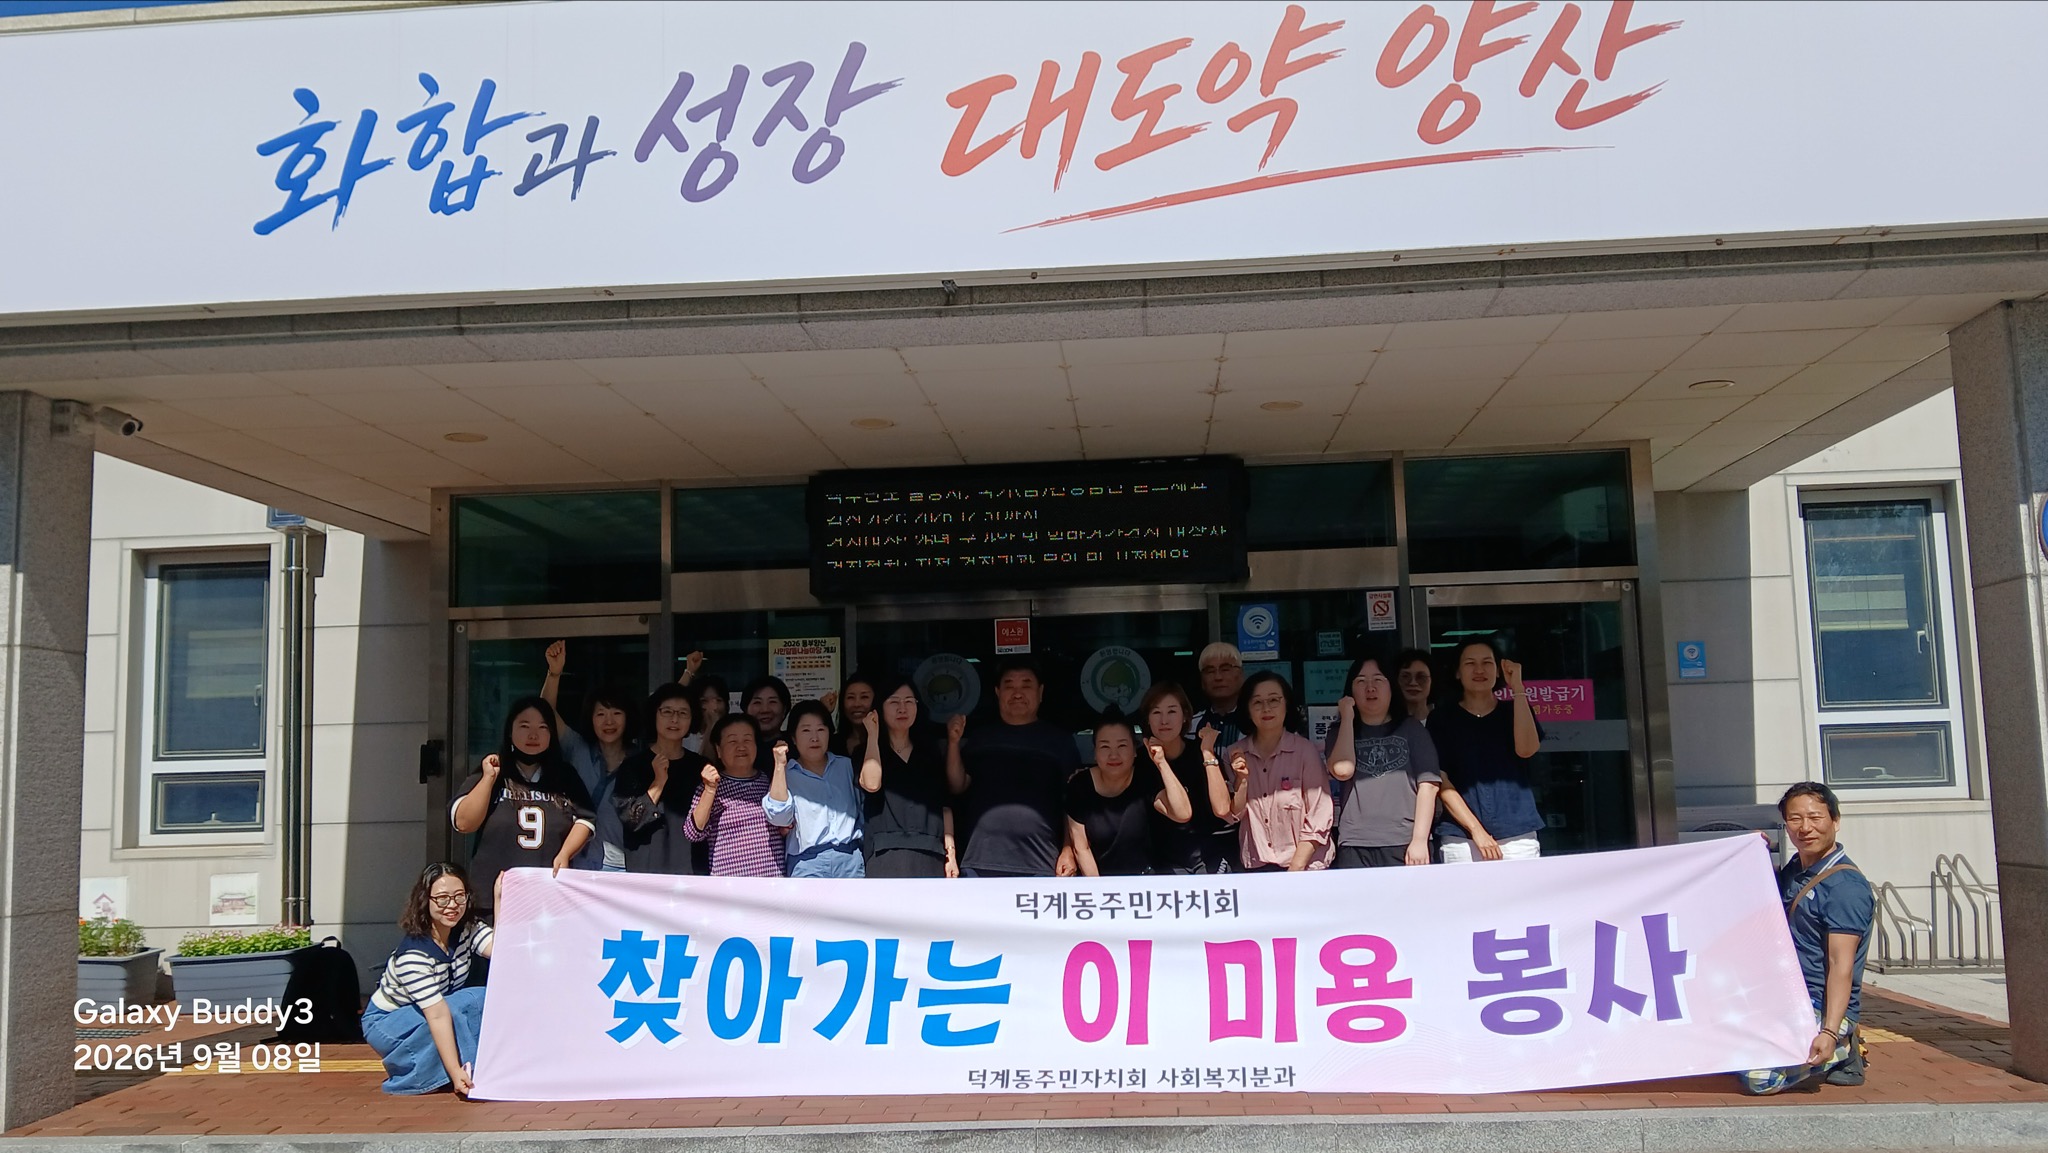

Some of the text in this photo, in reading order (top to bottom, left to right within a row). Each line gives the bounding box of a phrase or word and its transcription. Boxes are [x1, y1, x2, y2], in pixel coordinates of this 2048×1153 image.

[253, 0, 1684, 235] 화합과 성장 대도약 양산
[1494, 685, 1584, 702] 인원발급기
[516, 805, 546, 850] 9
[1016, 889, 1239, 920] 덕계동주민자치회
[597, 912, 1688, 1047] 찾아가는 이 미용 봉사
[968, 1066, 1297, 1090] 덕계동주민자치회 사회복지분과
